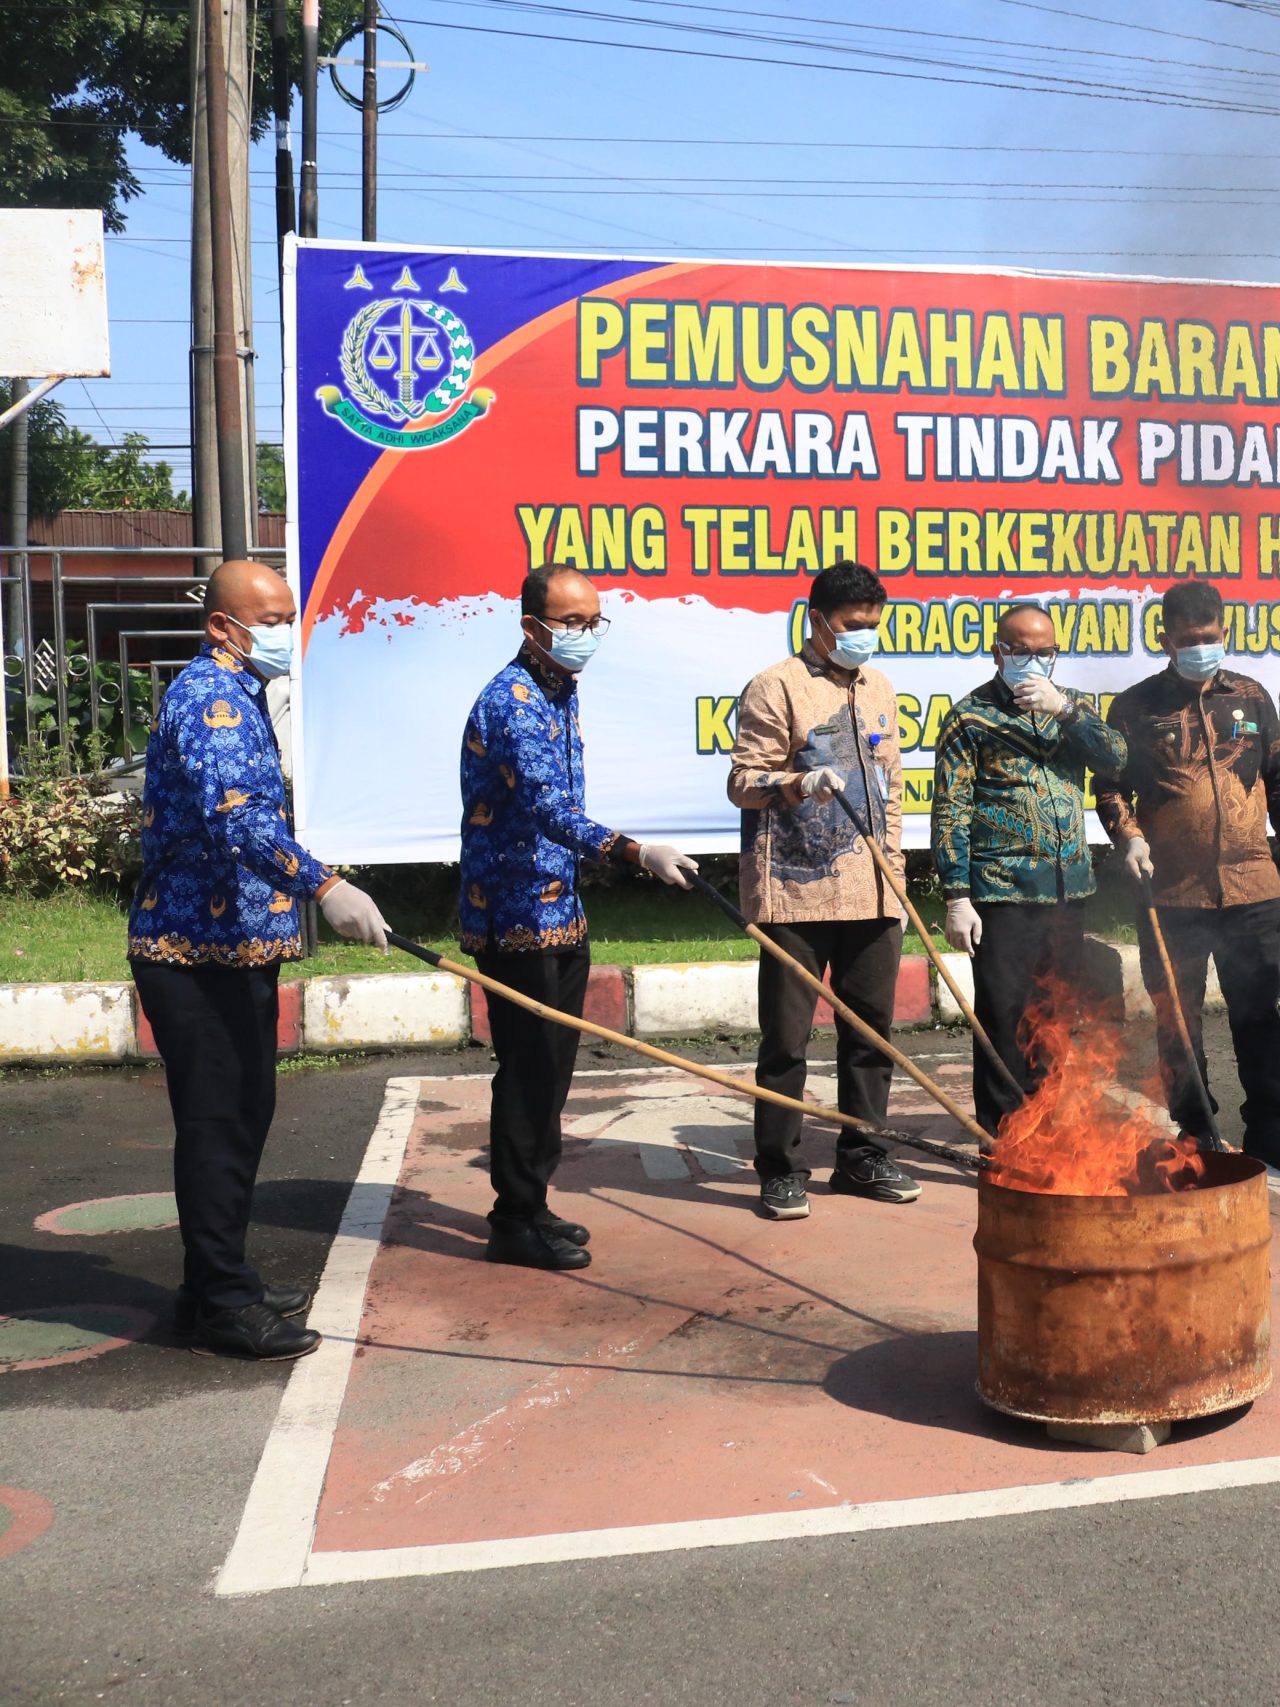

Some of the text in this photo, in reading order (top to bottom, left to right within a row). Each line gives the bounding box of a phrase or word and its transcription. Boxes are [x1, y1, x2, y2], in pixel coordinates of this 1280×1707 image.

[579, 299, 1065, 394] PEMUSNAHAN
[341, 407, 472, 444] SATYA ADHI WICAKSANA
[577, 407, 879, 478] PERKARA
[896, 415, 1121, 482] TINDAK
[517, 505, 668, 574] YANG
[683, 506, 858, 575] TELAH
[878, 508, 1242, 578] BERKEKUATAN
[1048, 602, 1131, 654] VAN
